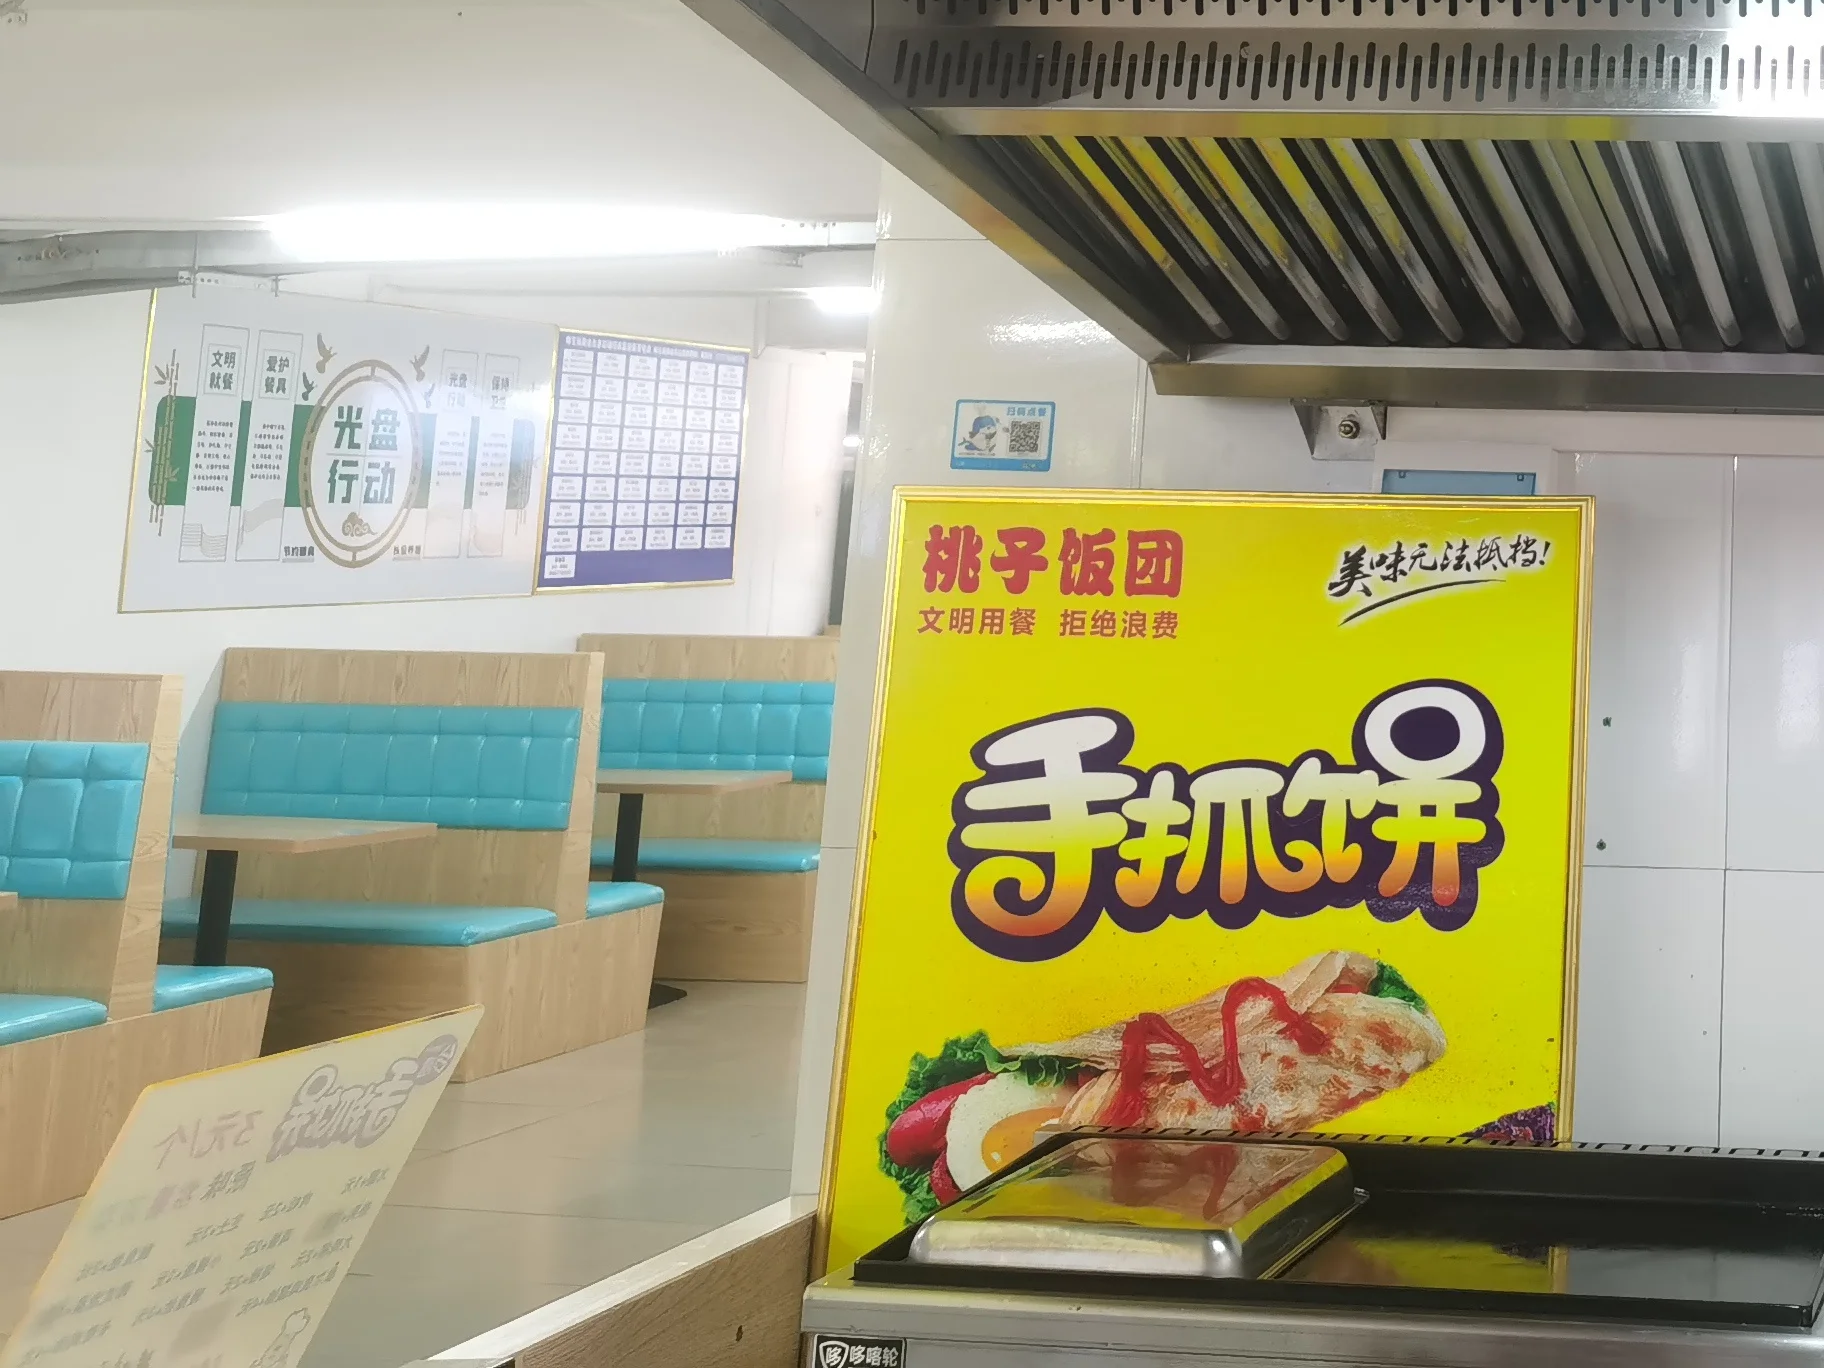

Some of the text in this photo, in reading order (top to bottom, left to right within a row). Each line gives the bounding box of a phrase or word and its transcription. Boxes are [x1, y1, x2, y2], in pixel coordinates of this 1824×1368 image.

[211, 350, 236, 369] 文明
[266, 355, 290, 373] 爱护
[334, 405, 400, 451] 光盘
[327, 459, 396, 504] 行动
[922, 524, 1184, 598] 桃子饭团
[917, 606, 1179, 640] 文明用餐 拒绝浪费
[953, 681, 1495, 950] 手抓饼
